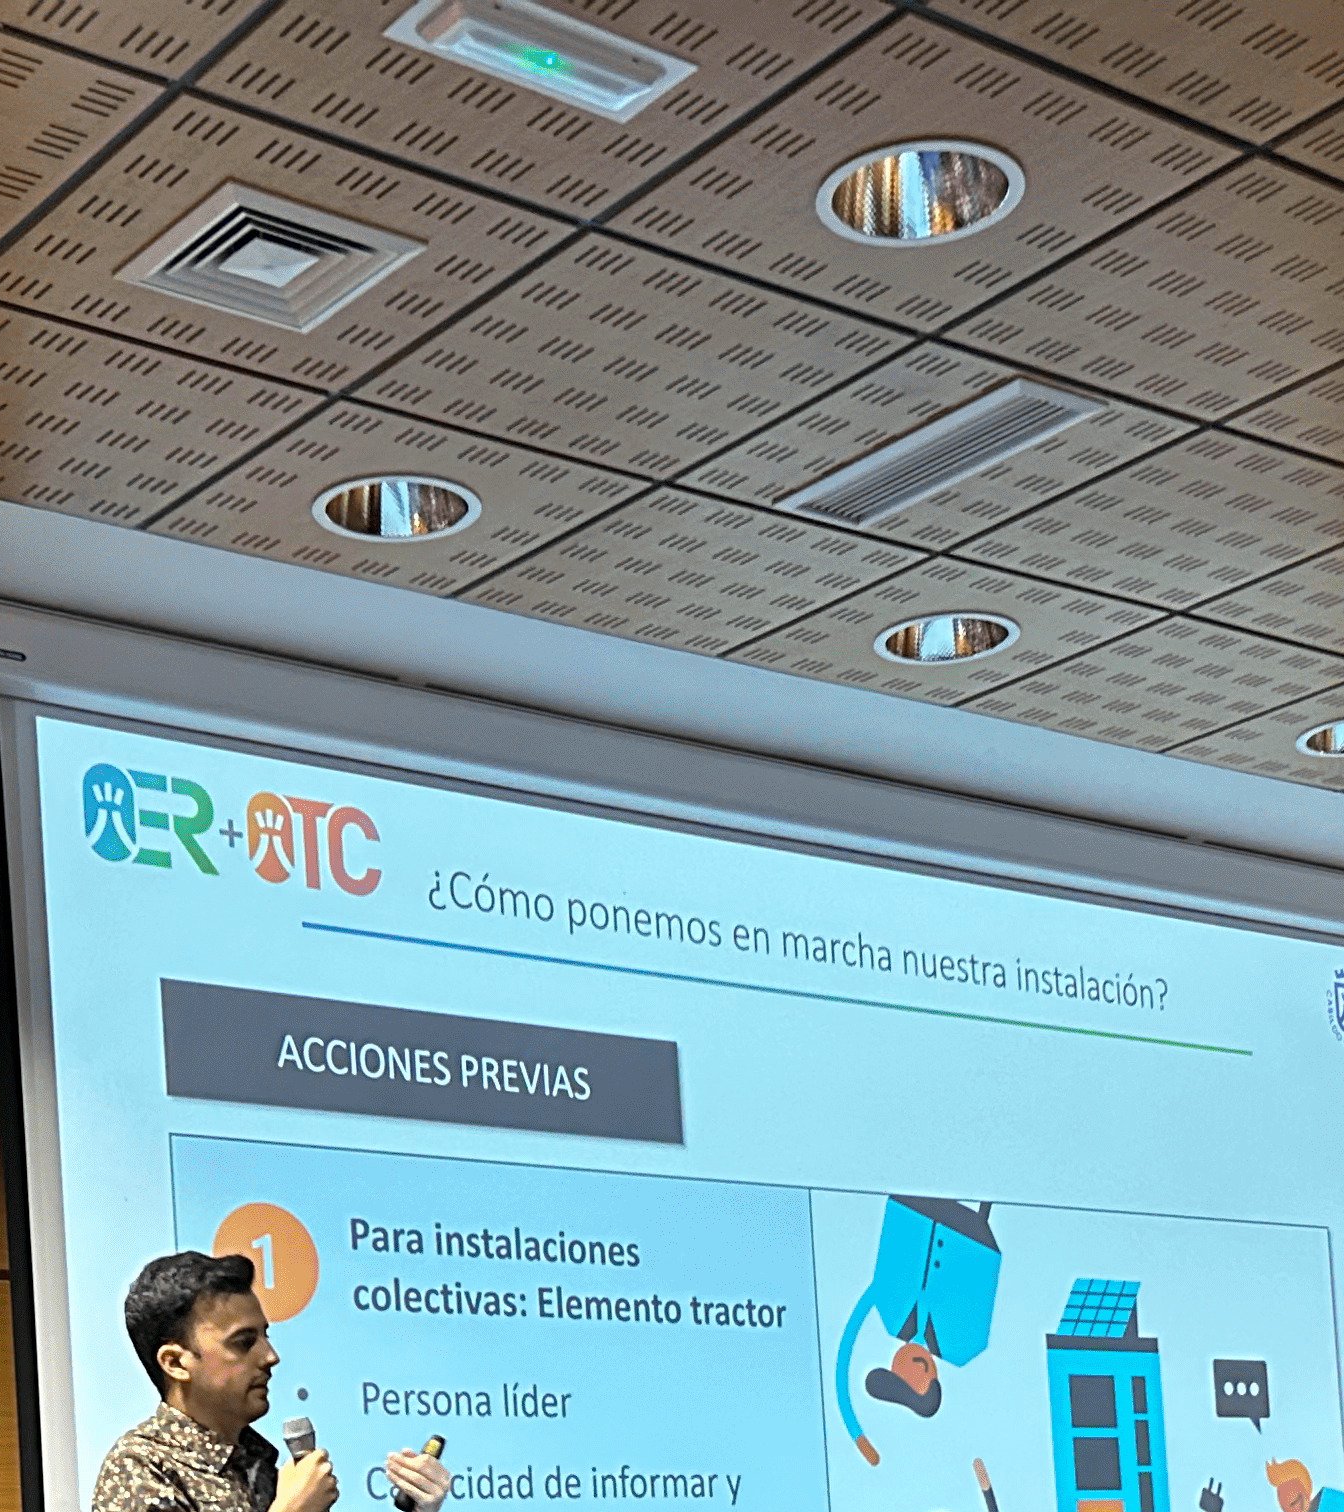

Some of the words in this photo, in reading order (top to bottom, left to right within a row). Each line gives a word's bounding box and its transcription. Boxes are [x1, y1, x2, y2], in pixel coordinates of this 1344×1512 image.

[428, 870, 555, 921] ¿Cómo
[567, 897, 723, 947] ponemos
[733, 924, 770, 955] en
[781, 928, 893, 972] marcha
[902, 948, 1007, 990] nuestra
[1015, 956, 1169, 1011] instalación?
[277, 1033, 452, 1085] ACCIONES
[460, 1054, 592, 1101] PREVIAS
[250, 1233, 275, 1290] 1
[350, 1219, 424, 1254] Para
[434, 1222, 641, 1267] instalaciones
[353, 1276, 528, 1320] colectivas:
[538, 1286, 682, 1324] Elemento
[690, 1293, 788, 1329] tractor
[362, 1382, 492, 1417] Persona
[503, 1381, 572, 1418] líder
[366, 1465, 534, 1501] Ccidad
[544, 1464, 582, 1500] de
[592, 1463, 719, 1499] informar
[725, 1474, 743, 1506] y
